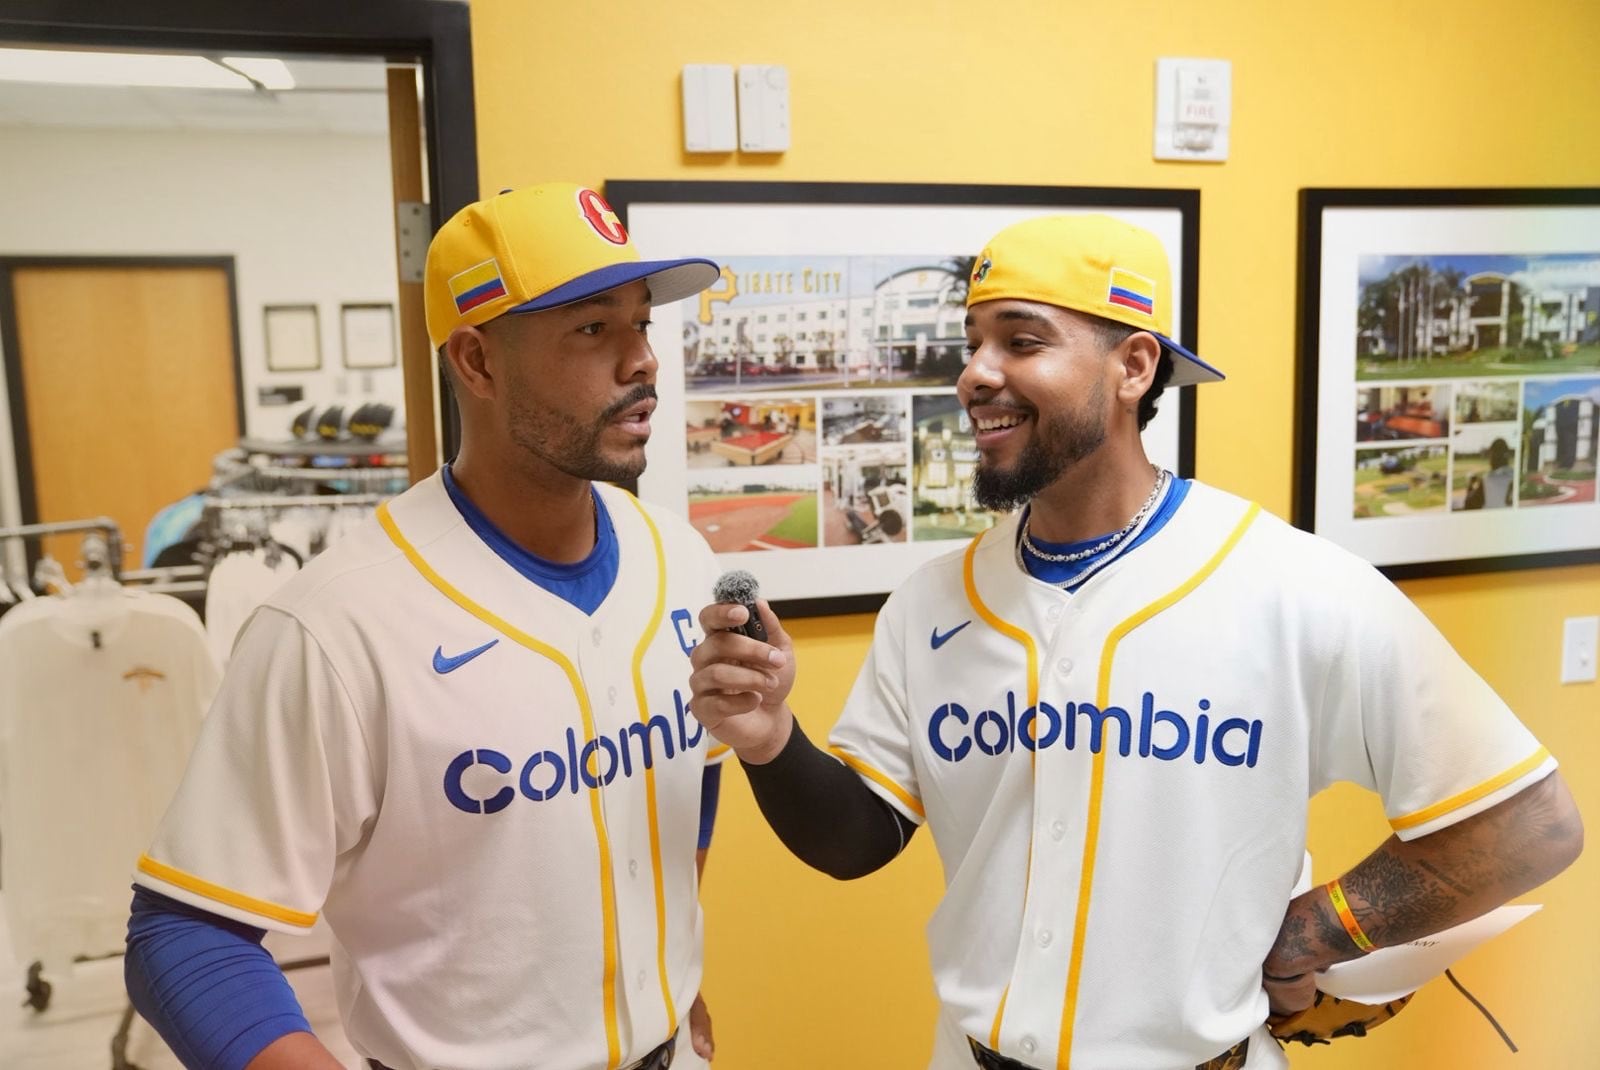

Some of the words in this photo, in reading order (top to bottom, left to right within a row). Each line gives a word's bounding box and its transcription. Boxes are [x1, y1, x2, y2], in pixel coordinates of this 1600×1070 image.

[578, 188, 628, 246] C
[671, 608, 697, 658] C
[443, 689, 704, 815] Colomb
[928, 691, 1263, 769] Colombia
